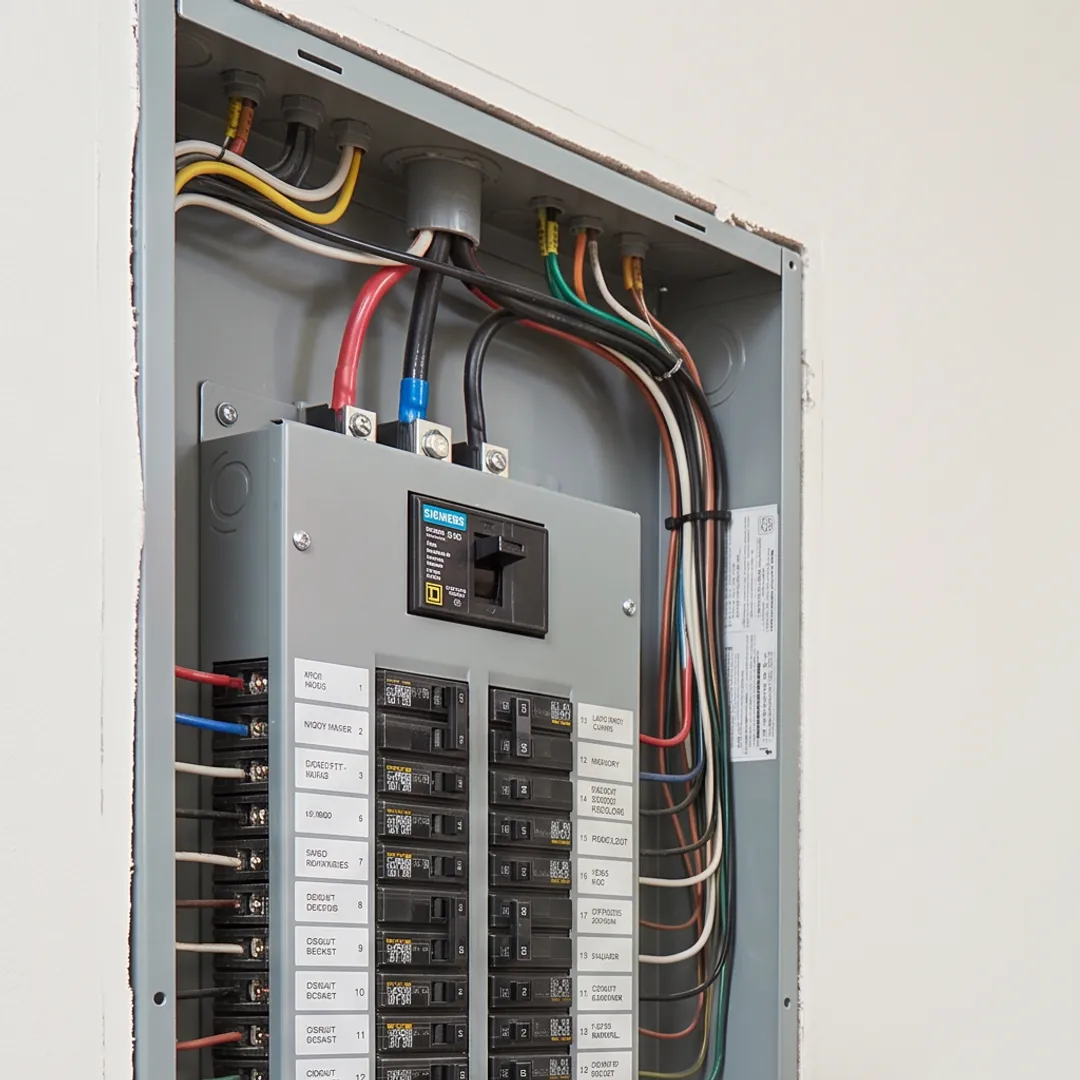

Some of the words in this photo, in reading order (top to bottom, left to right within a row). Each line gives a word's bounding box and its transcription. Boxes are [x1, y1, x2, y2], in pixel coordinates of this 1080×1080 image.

[358, 901, 362, 909] 8
[358, 944, 363, 952] 9
[355, 988, 364, 996] 10
[356, 1031, 365, 1039] 11
